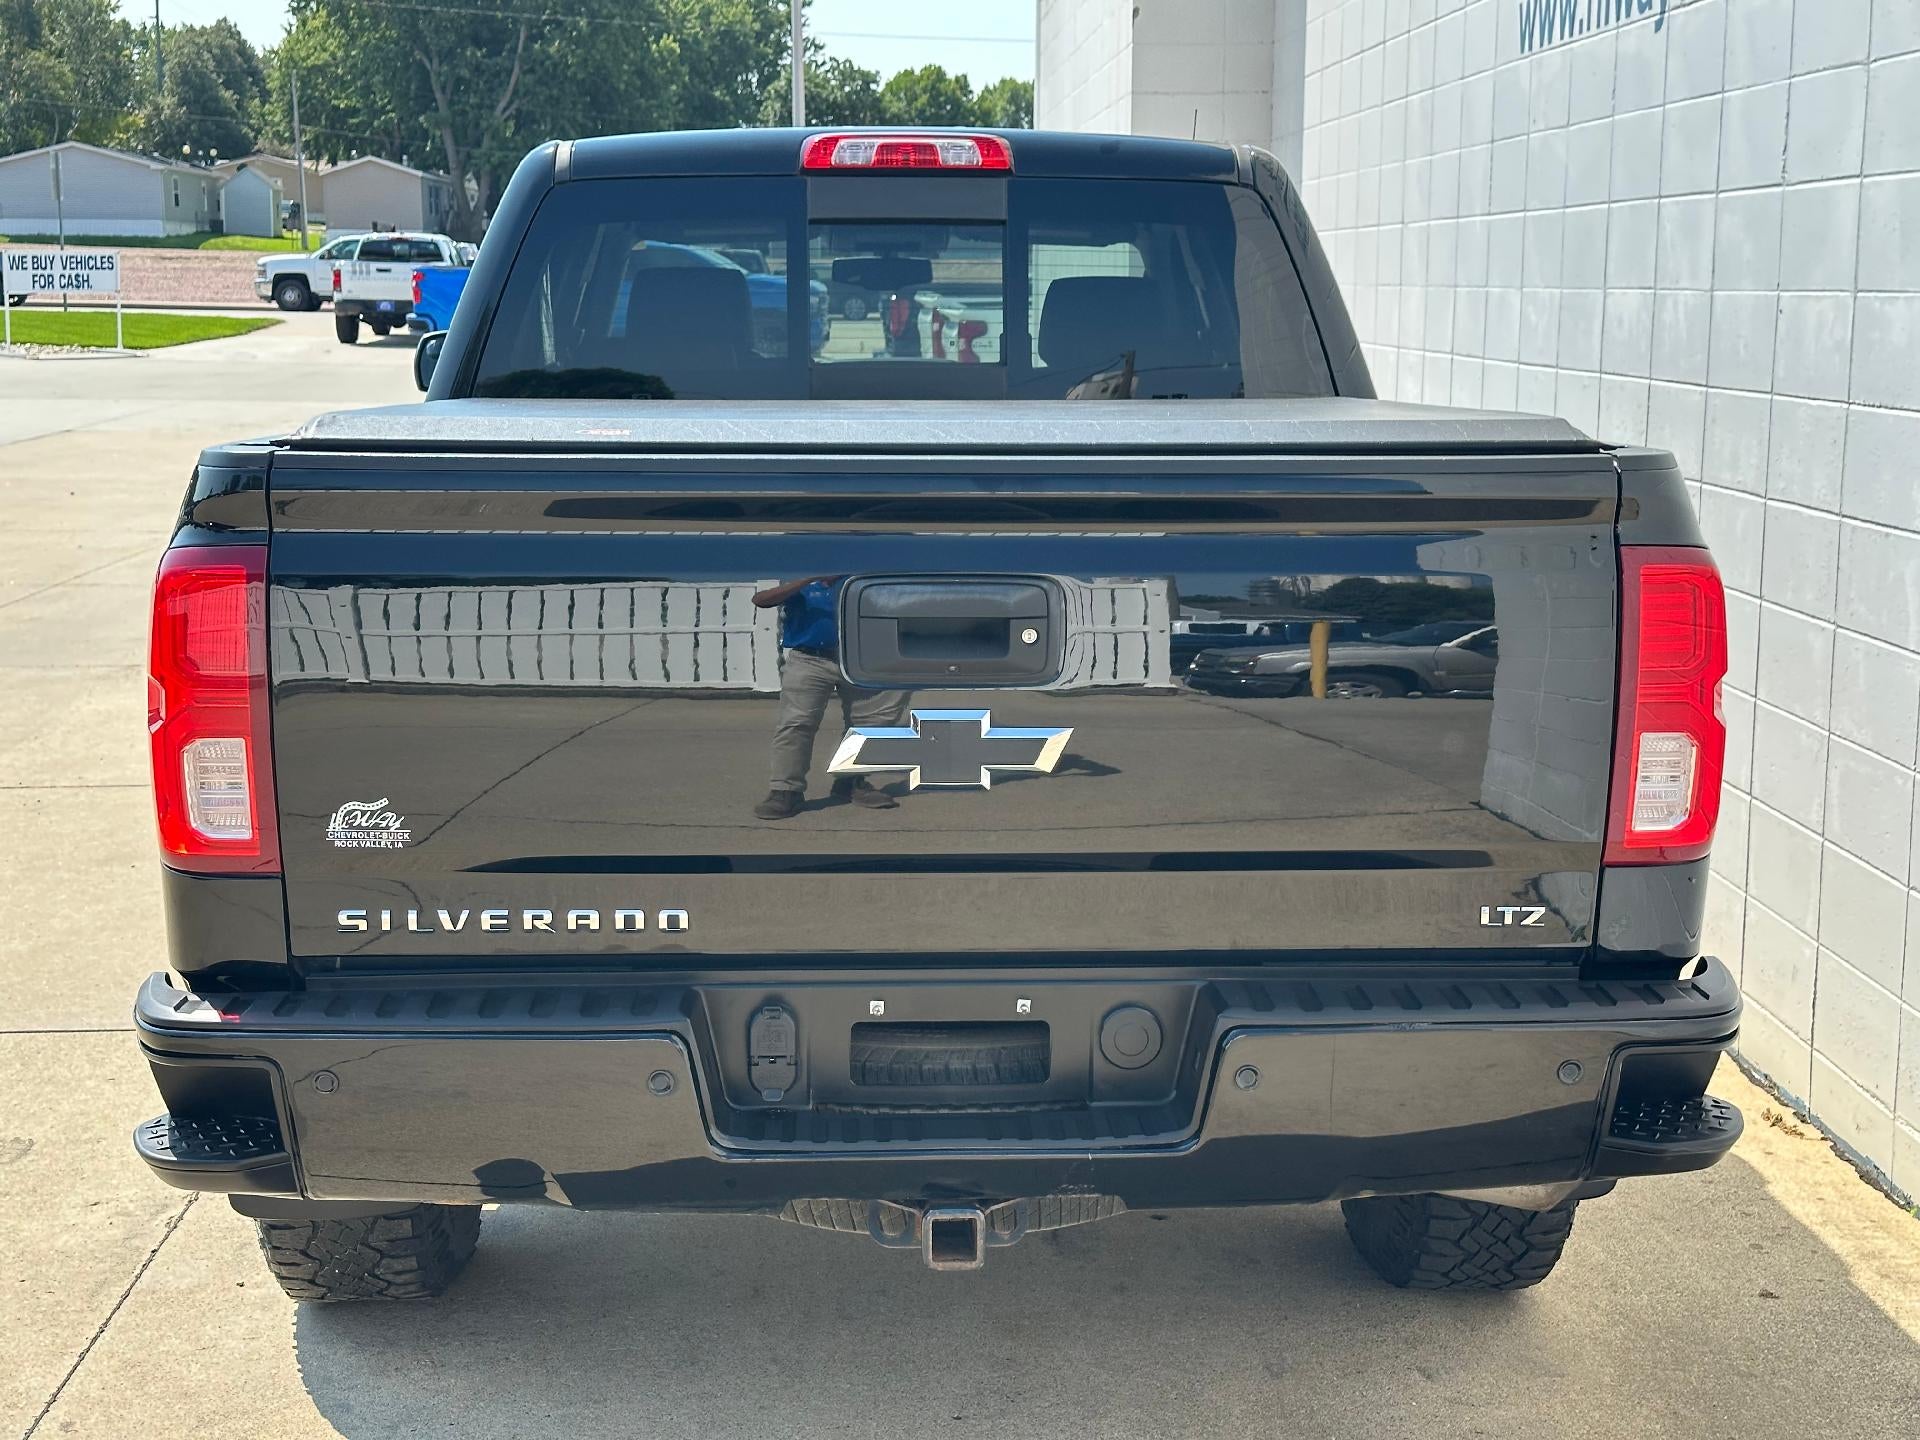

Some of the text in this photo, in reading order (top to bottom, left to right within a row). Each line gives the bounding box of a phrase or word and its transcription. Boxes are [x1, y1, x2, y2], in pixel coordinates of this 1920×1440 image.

[8, 255, 114, 271] WE BUY VEHICLES
[32, 274, 55, 289] FOR
[334, 840, 359, 849] ROCK
[394, 840, 404, 849] IA
[337, 909, 690, 933] SILVERADO
[1480, 906, 1546, 926] LTZ
